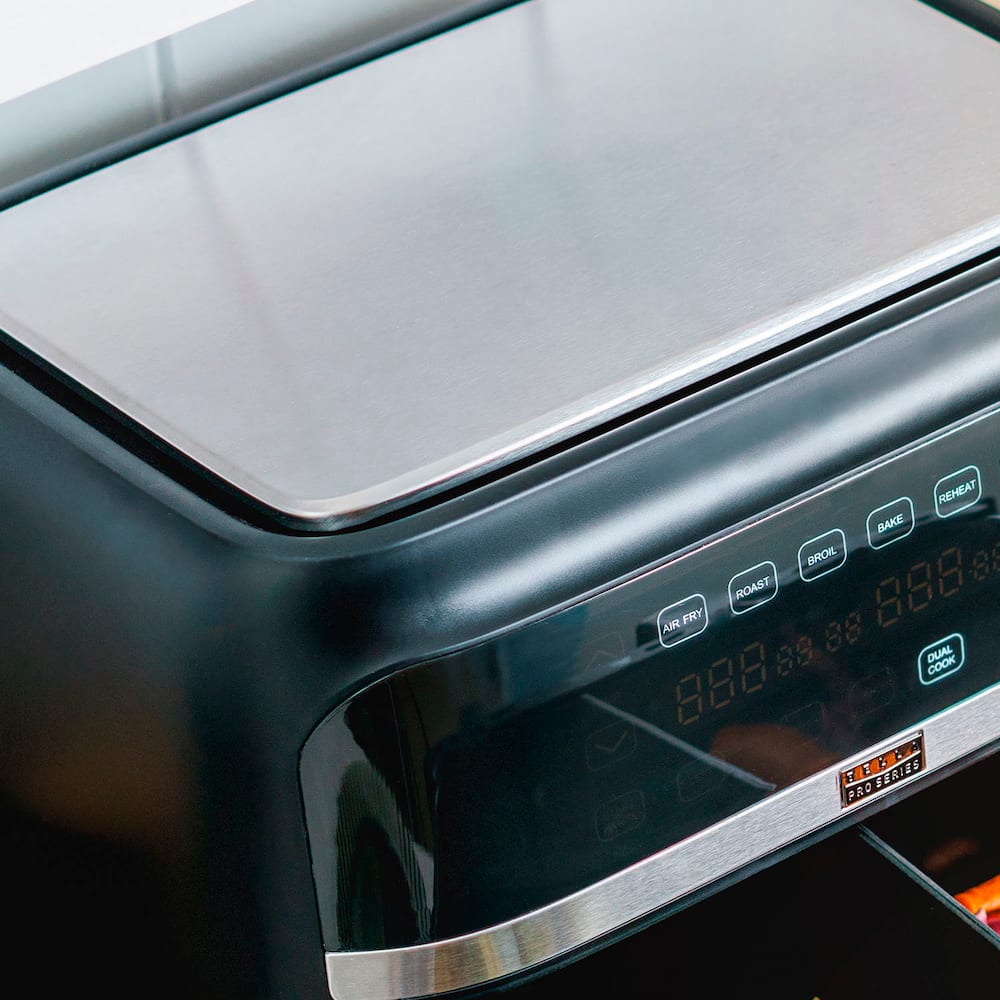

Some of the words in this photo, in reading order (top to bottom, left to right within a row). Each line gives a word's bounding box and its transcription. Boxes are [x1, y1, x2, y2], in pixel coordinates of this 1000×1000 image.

[939, 479, 976, 504] REHEAT
[878, 513, 904, 533] BAKE
[807, 546, 837, 566] BROIL
[736, 576, 770, 600] ROAST
[663, 619, 680, 634] AIR
[682, 607, 703, 625] FRY
[927, 645, 953, 663] DUAL
[927, 654, 956, 675] COOK
[848, 782, 872, 801] PRO
[876, 759, 920, 788] SERIES
